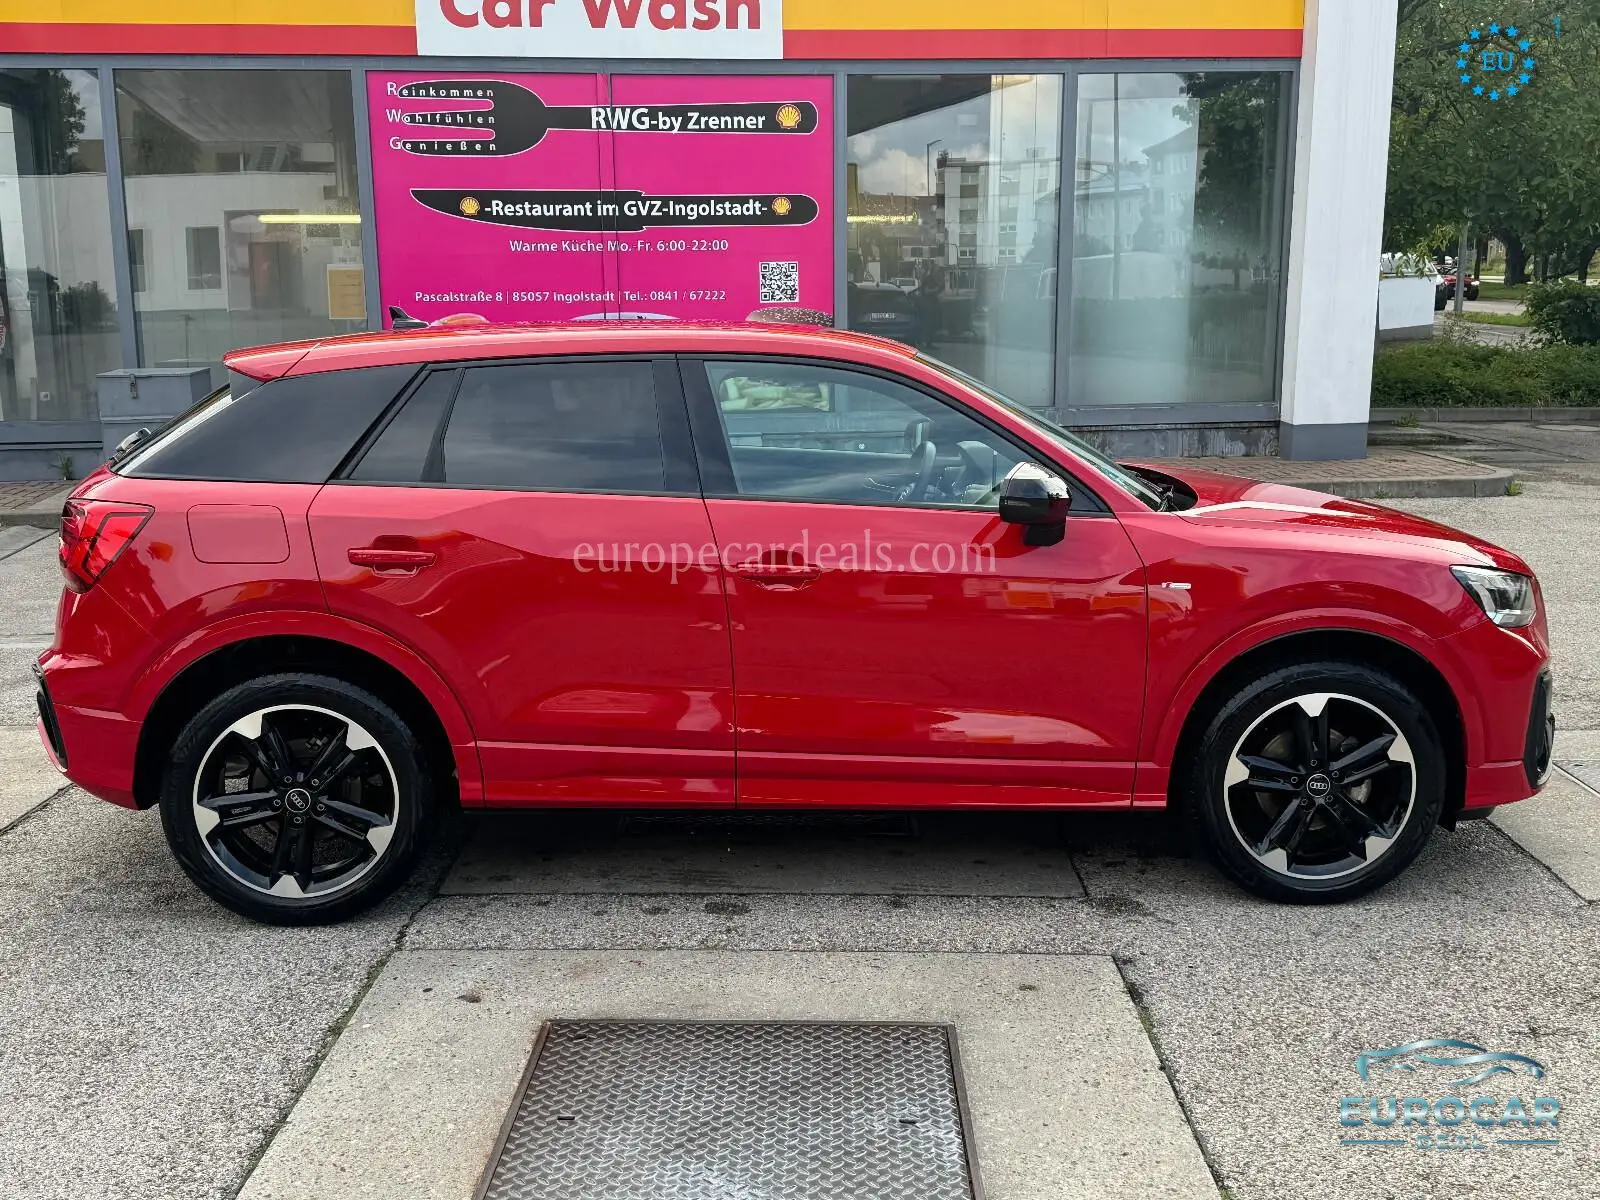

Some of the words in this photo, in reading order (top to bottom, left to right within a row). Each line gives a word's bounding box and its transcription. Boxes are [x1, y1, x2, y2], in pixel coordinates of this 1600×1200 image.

[386, 82, 494, 98] Reinkommen
[386, 109, 495, 124] Wohlfühlen
[590, 107, 682, 132] RWG-by
[687, 112, 766, 129] Zrenner
[389, 137, 496, 151] Genießen
[484, 200, 593, 217] -Restaurant
[597, 201, 619, 216] im
[623, 199, 768, 219] GVZ-Ingolstadt-
[509, 240, 558, 252] Warme
[561, 239, 604, 252] Küche
[607, 239, 654, 252] Mo.-Fr.
[656, 239, 729, 252] 6:00-22:00
[415, 291, 493, 303] Pascalstraße
[495, 292, 503, 302] 8
[512, 292, 550, 303] 85057
[553, 291, 615, 303] Ingolstadt
[623, 291, 648, 302] Tel.:
[650, 291, 679, 301] 0841
[689, 290, 726, 301] 67222
